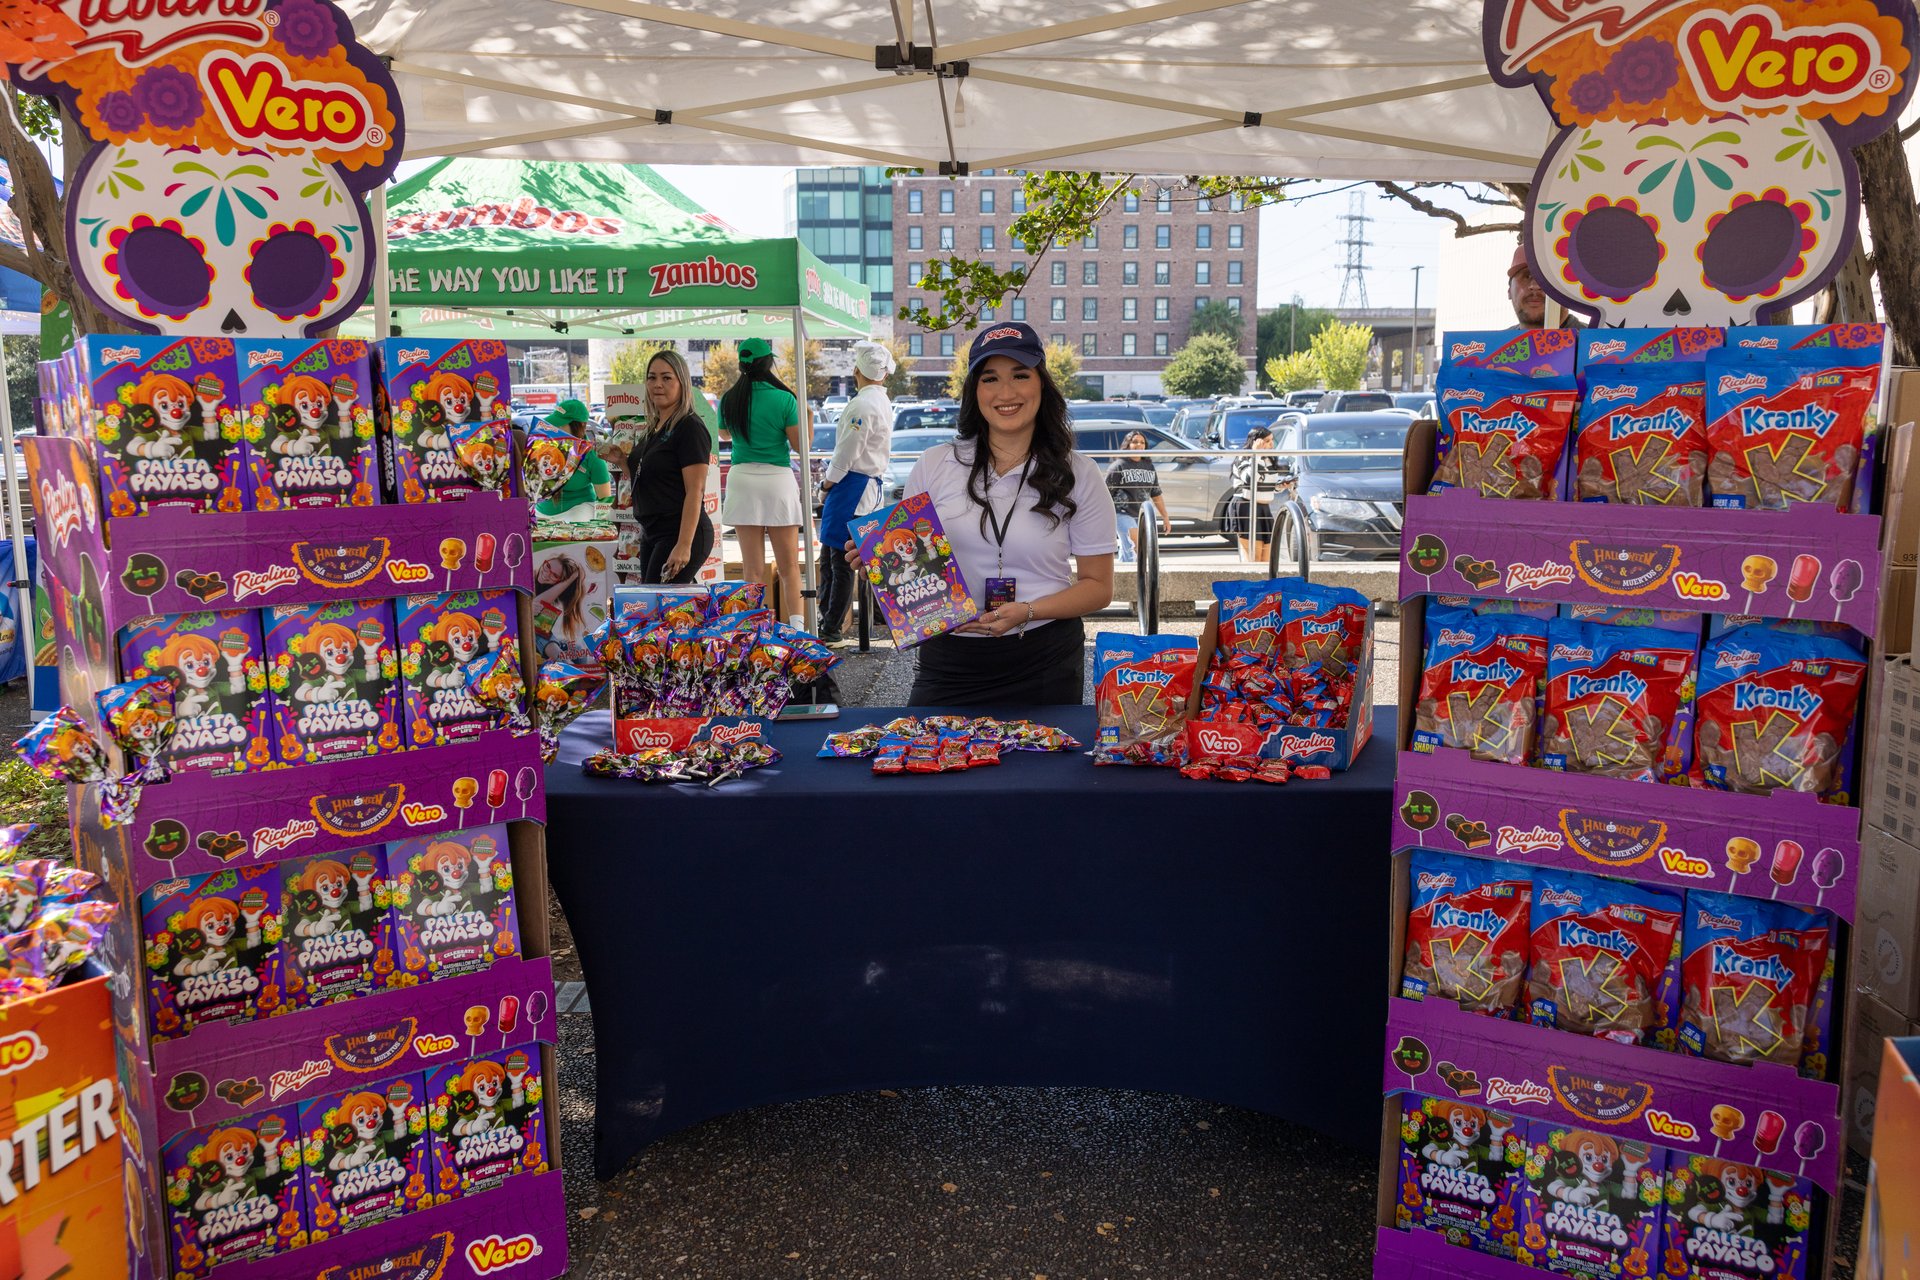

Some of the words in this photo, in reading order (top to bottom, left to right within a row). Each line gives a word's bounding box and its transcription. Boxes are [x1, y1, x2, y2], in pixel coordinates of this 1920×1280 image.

[1696, 23, 1861, 95] Vero
[213, 63, 360, 134] Vero
[389, 267, 420, 293] HE
[429, 266, 483, 293] WAY
[491, 266, 540, 293] YOU
[550, 267, 598, 294] LIKE
[607, 267, 628, 294] IT
[650, 256, 757, 297] Zambos
[102, 347, 141, 365] Ricolino
[248, 349, 283, 368] Ricolino
[398, 348, 430, 366] Ricolino
[1451, 341, 1485, 359] Ricolino
[1589, 339, 1627, 359] Ricolino
[1666, 387, 1677, 396] 20
[1680, 386, 1703, 396] PACK
[1718, 375, 1767, 395] Ricolino
[1800, 377, 1812, 389] 20
[1817, 375, 1841, 386] PACK
[1443, 389, 1484, 402] Ricolino
[1511, 395, 1522, 404] 20
[1524, 399, 1546, 407] PACK
[1592, 385, 1638, 403] Ricolino
[1461, 412, 1538, 442] Kranky
[1610, 405, 1695, 440] Kranky
[1741, 402, 1839, 438] Kranky
[136, 458, 210, 474] PALETA
[281, 456, 345, 472] PALETA
[426, 451, 454, 464] PAL
[129, 471, 220, 492] PAYASO
[273, 468, 352, 488] PAYASO
[420, 463, 470, 480] PAYA
[705, 502, 716, 511] UO
[314, 544, 371, 563] HALLOWEEN
[1593, 548, 1657, 565] HALLOWEEN
[344, 561, 372, 580] MUERTOS
[388, 561, 428, 581] Vero
[616, 563, 631, 571] SNACK
[1507, 561, 1572, 592] Ricolino
[235, 566, 297, 599] Ricolino
[897, 572, 939, 596] PALETA
[1622, 569, 1656, 587] MUERTOS
[1675, 574, 1724, 599] Vero
[896, 579, 947, 607] PAYASO
[1222, 596, 1248, 610] Ricolino
[1266, 595, 1274, 604] 20
[1289, 599, 1319, 613] Ricolino
[1234, 610, 1284, 635] Kranky
[1302, 619, 1348, 640] Kranky
[1438, 630, 1475, 646] Ricolino
[1507, 640, 1529, 651] PACK
[1103, 650, 1134, 661] Ricolino
[1153, 653, 1160, 664] 20
[1162, 653, 1178, 662] PACK
[1552, 644, 1592, 661] Ricolino
[1619, 652, 1631, 661] 20
[1633, 655, 1658, 665] PACK
[1715, 650, 1760, 668] Ricolino
[1117, 667, 1173, 687] Kranky
[1451, 658, 1524, 688] Kranky
[1791, 661, 1803, 673] 20
[1567, 671, 1648, 704] Kranky
[303, 700, 372, 717] PALETA
[428, 700, 487, 719] PAYAS
[1734, 683, 1823, 721] Kranky
[176, 713, 238, 733] ALETA
[298, 711, 379, 735] PAYASO
[711, 722, 760, 745] Ricolino
[632, 730, 671, 747] Vero
[1201, 731, 1241, 753] Vero
[1281, 734, 1335, 759] Ricolino
[331, 791, 386, 814] HALLOWEEN
[361, 807, 387, 828] MUERTOS
[404, 804, 442, 825] Vero
[254, 820, 316, 858] Ricolino
[1497, 826, 1562, 854] Ricolino
[1581, 819, 1644, 840] HALLOWEEN
[1610, 843, 1643, 858] MUERTOS
[1661, 849, 1710, 875] Vero
[152, 878, 190, 900] Ricolino
[1417, 873, 1457, 888] Ricolino
[1481, 886, 1491, 896] 20
[1494, 887, 1514, 897] PACK
[1540, 889, 1582, 906] Ricolino
[427, 910, 486, 930] PALETA
[1431, 902, 1508, 940] Kranky
[1609, 905, 1620, 917] 20
[1623, 910, 1645, 923] PACK
[1698, 911, 1742, 931] Ricolino
[304, 928, 366, 952] PALETA
[420, 921, 494, 946] PAYASO
[1558, 920, 1638, 960] Kranky
[298, 939, 374, 967] PAYASO
[184, 966, 252, 990] PALETA
[1713, 944, 1795, 992] Kranky
[176, 977, 260, 1006] PAYASO
[344, 1025, 399, 1050] HALLOWEEN
[416, 1035, 454, 1057] Vero
[374, 1042, 400, 1062] MUERTOS
[271, 1061, 329, 1100] Ricolino
[1569, 1076, 1631, 1100] HALLOWEEN
[1487, 1078, 1549, 1105] Ricolino
[1598, 1103, 1630, 1116] MUERTOS
[1648, 1111, 1694, 1139] Vero
[461, 1125, 516, 1149] PALETA
[454, 1135, 524, 1165] PAYASO
[338, 1157, 400, 1181] PALETA
[1428, 1162, 1490, 1188] PALETA
[332, 1166, 407, 1201] PAYASO
[1421, 1173, 1496, 1204] PAYASO
[205, 1195, 272, 1224] PALETA
[1554, 1200, 1621, 1229] PALETA
[198, 1204, 279, 1241] PAYASO
[1545, 1212, 1628, 1246] PAYASO
[1694, 1227, 1767, 1254] PALETA
[469, 1238, 533, 1274] Vero
[1687, 1238, 1775, 1272] PAYASO
